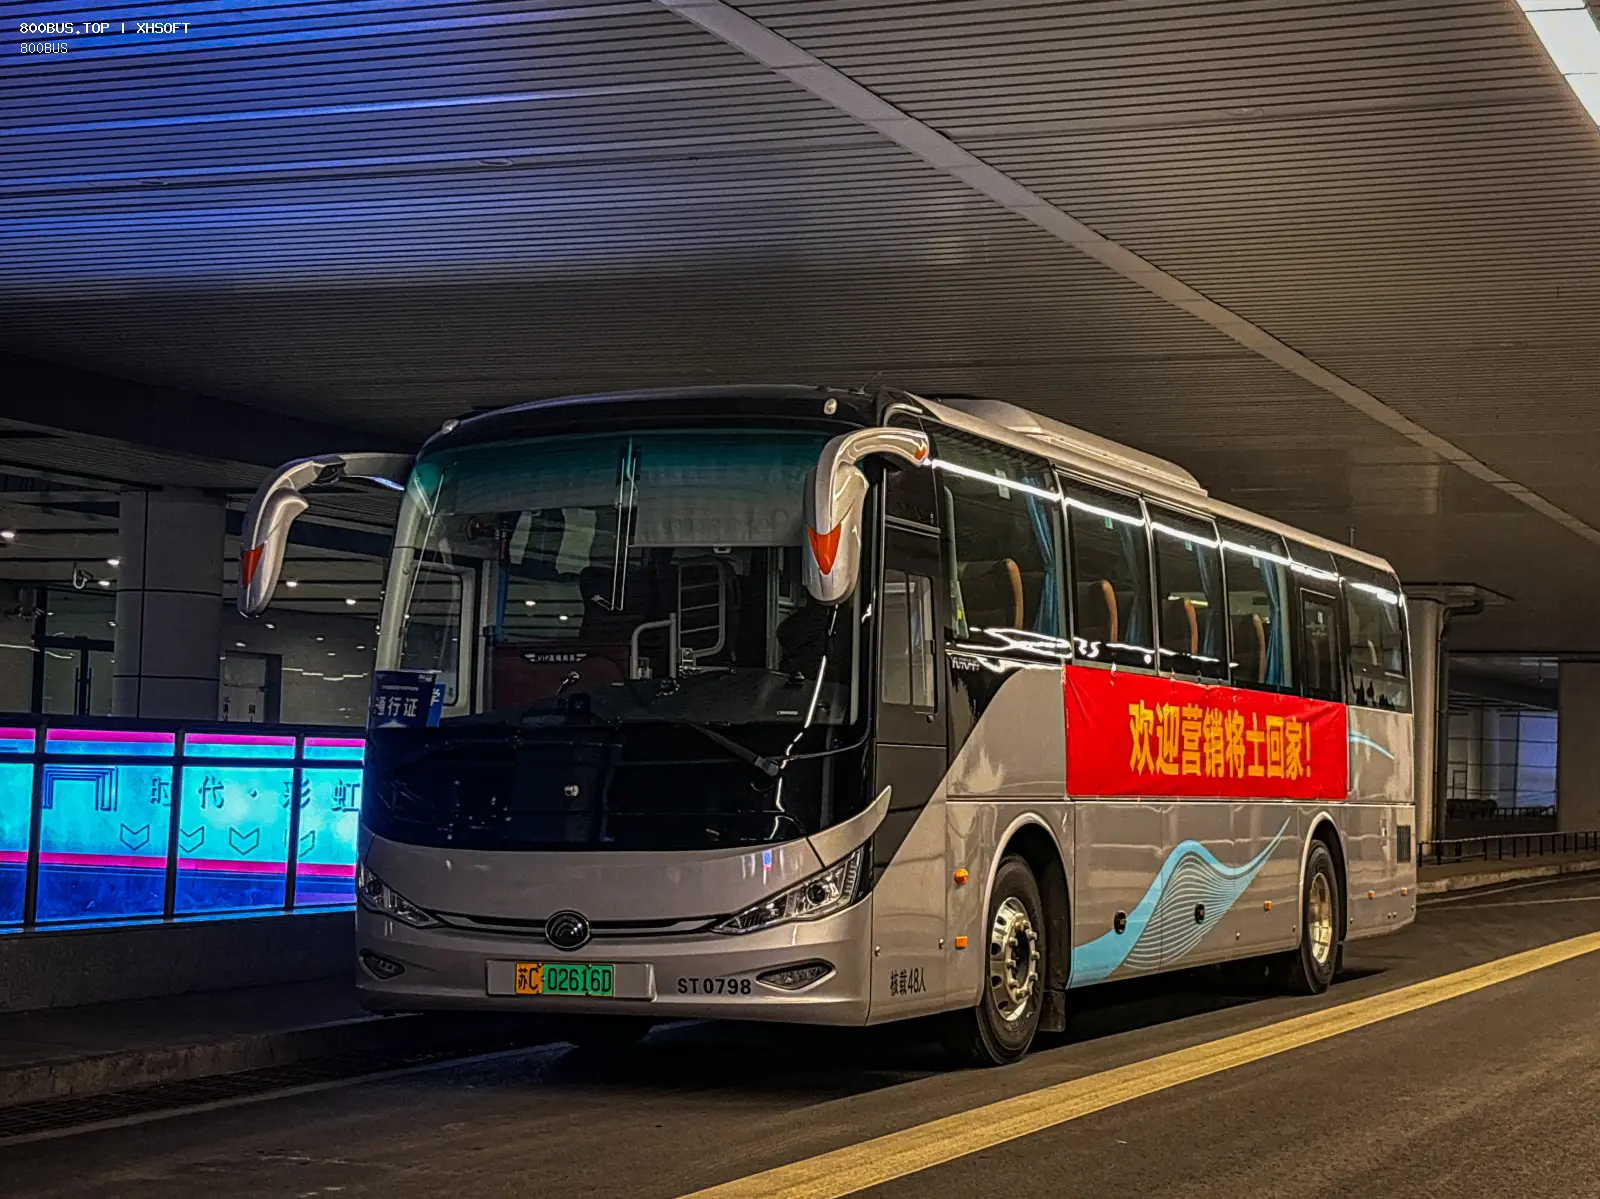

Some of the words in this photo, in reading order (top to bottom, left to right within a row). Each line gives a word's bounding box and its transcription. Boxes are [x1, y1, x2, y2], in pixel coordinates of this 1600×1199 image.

[373, 696, 419, 717] 通行证
[889, 966, 927, 997] 核载48人
